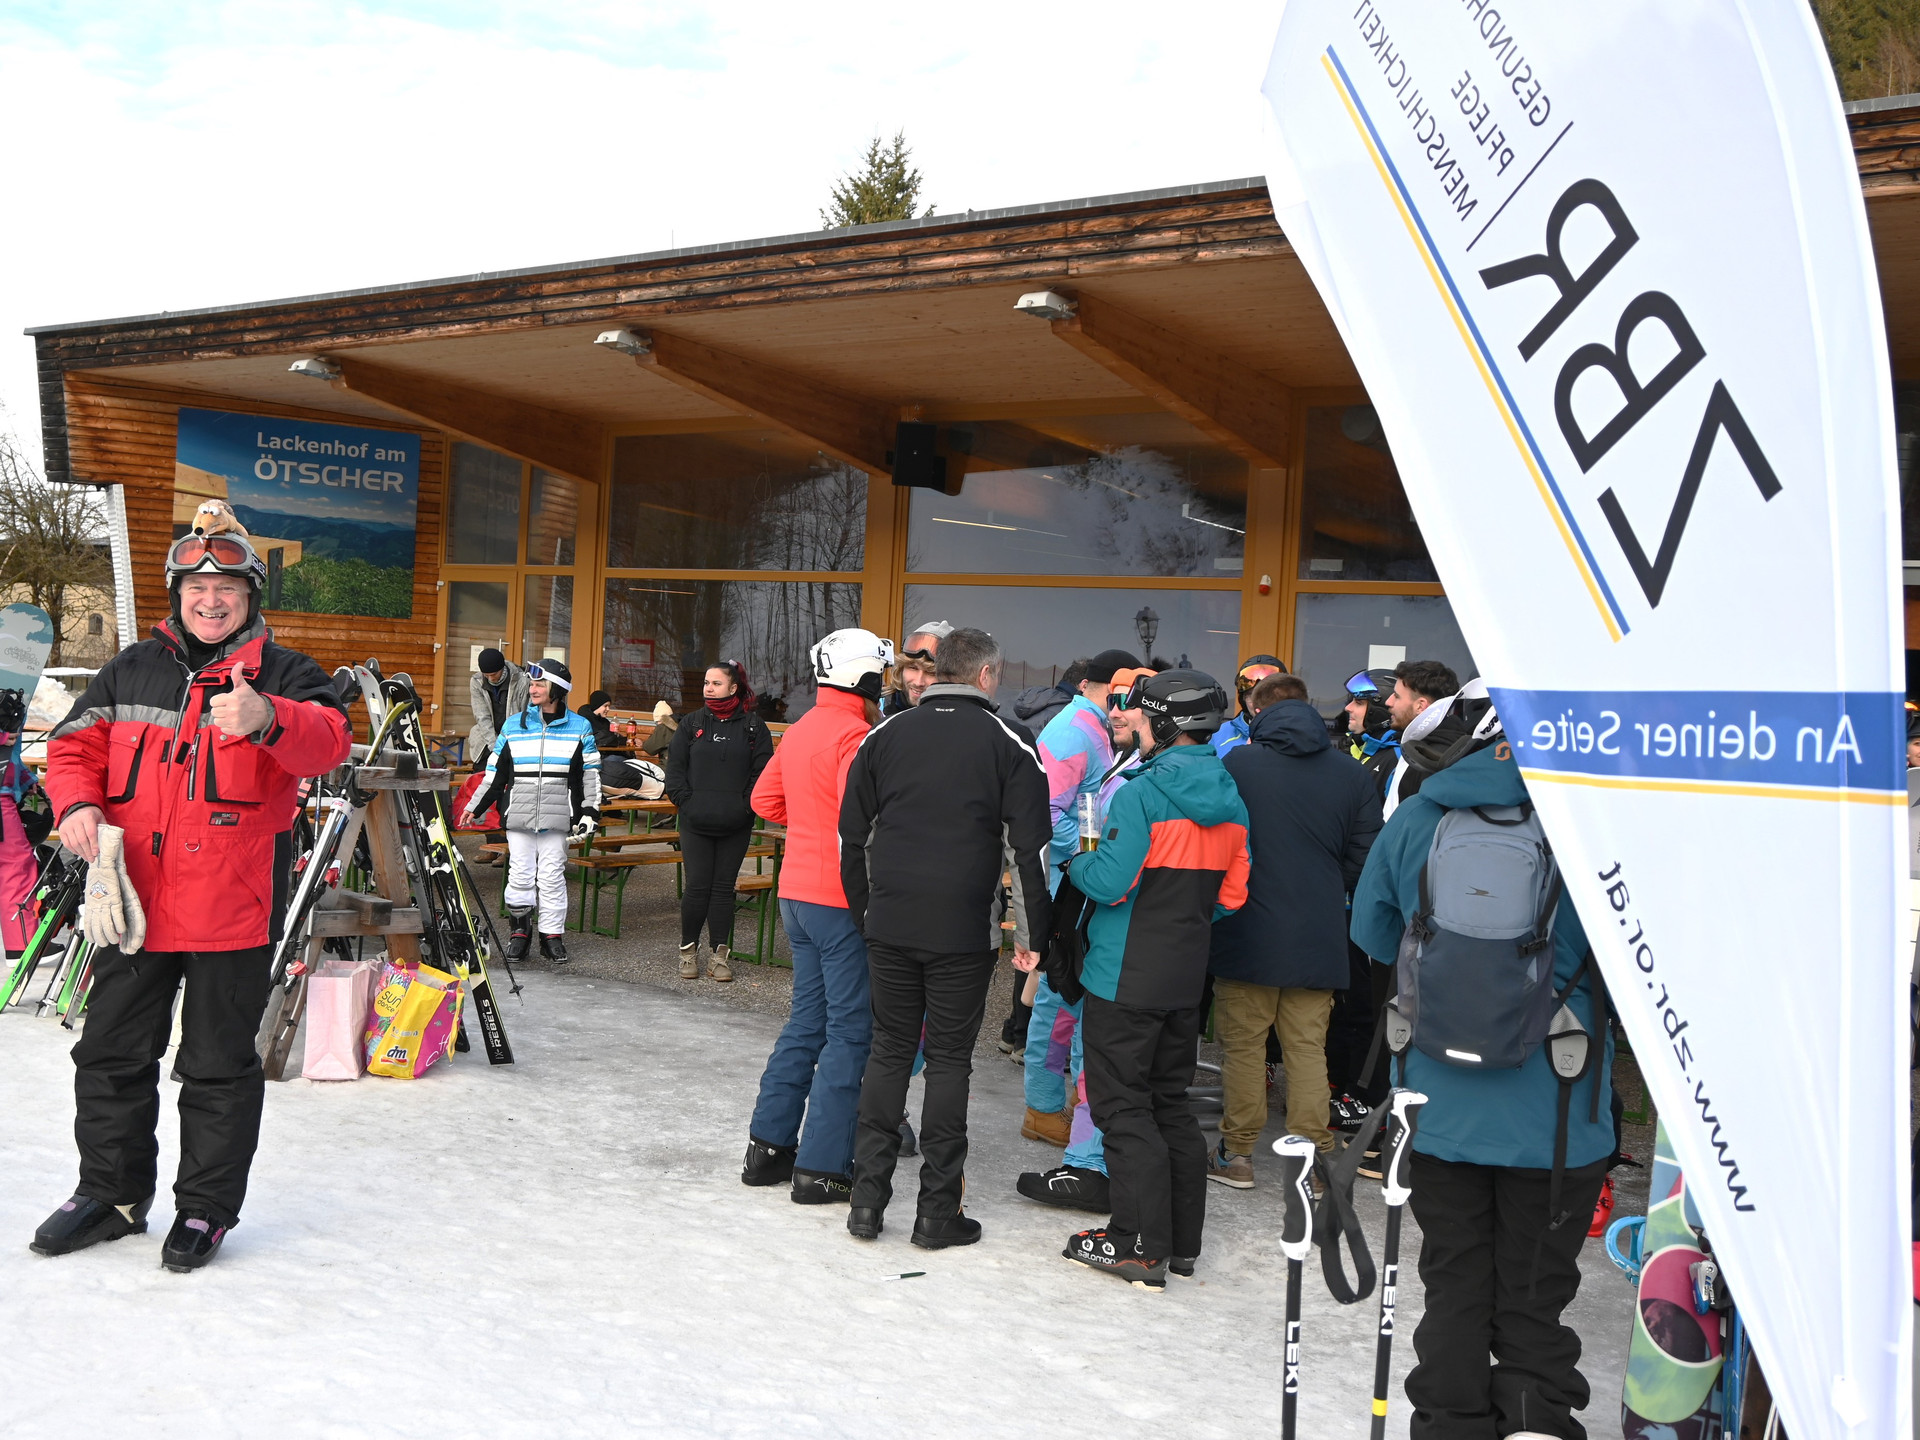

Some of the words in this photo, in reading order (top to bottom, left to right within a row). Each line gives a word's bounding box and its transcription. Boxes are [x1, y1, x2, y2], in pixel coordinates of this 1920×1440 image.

[256, 431, 370, 459] Lackenhof
[374, 447, 406, 463] am
[254, 453, 404, 493] ÖTSCHER
[1141, 695, 1168, 713] bollé
[377, 999, 395, 1013] dance
[482, 998, 502, 1048] REBELS
[386, 1045, 407, 1059] dm
[1391, 1128, 1404, 1148] LEKI
[1303, 1180, 1314, 1200] LEKI
[1381, 1264, 1398, 1335] LEKI
[1285, 1321, 1300, 1394] LEKI
